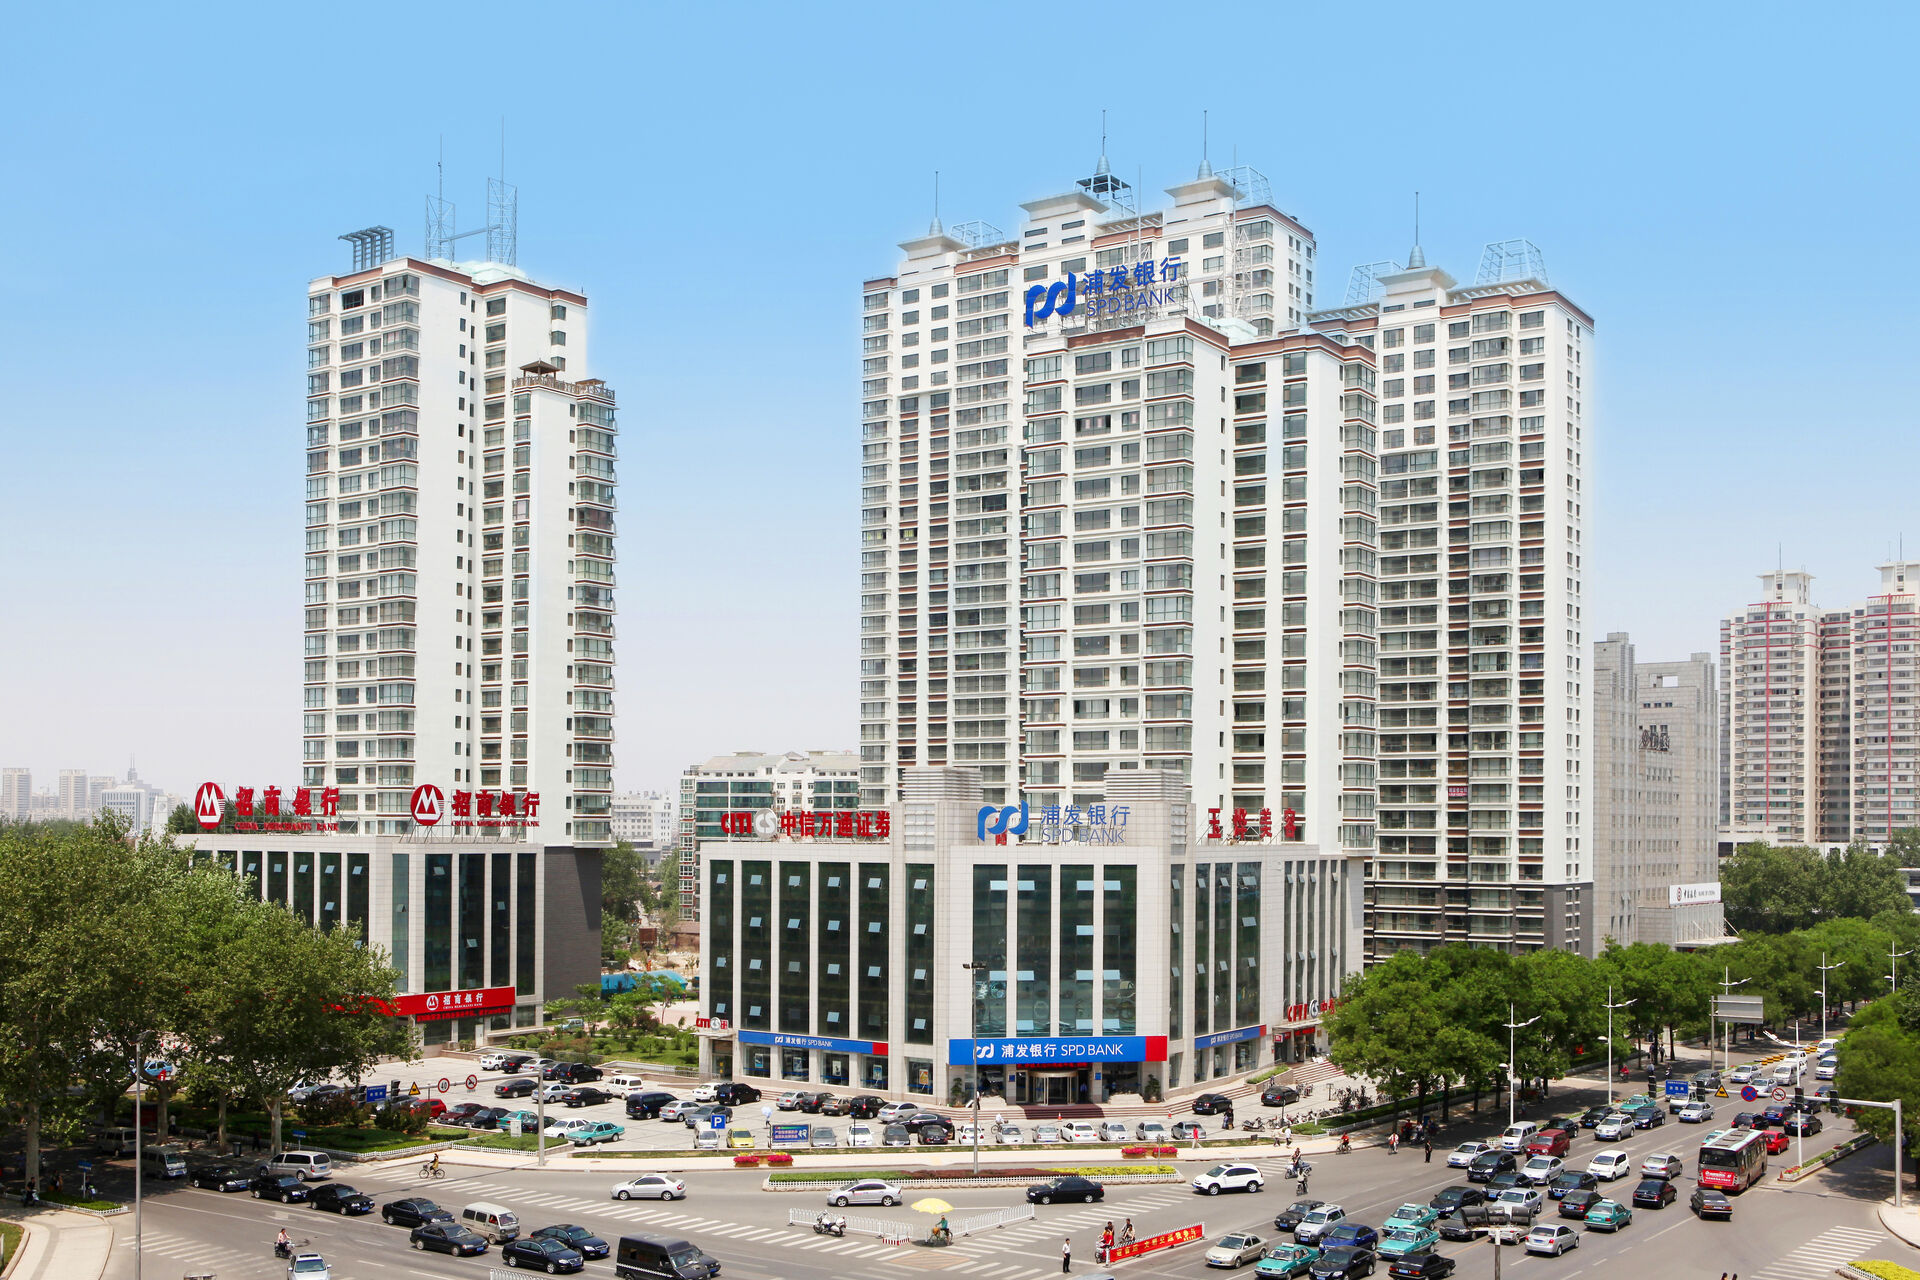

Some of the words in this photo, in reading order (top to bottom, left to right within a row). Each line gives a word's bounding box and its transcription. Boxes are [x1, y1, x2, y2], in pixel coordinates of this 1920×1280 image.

[1081, 256, 1182, 295] 浦发银行
[1086, 296, 1121, 317] SPD
[1124, 287, 1176, 312] BANK
[235, 785, 340, 817] 招商银行
[452, 789, 540, 817] 招商银行
[1041, 804, 1131, 826] 浦发银行
[234, 822, 258, 831] CHINA
[263, 822, 312, 831] MERCHANTS
[316, 822, 340, 831] BANK
[780, 810, 891, 837] 中信万通证券
[1041, 827, 1074, 843] SPD
[1079, 827, 1126, 843] BANK
[443, 993, 484, 1006] 招商银行
[785, 1036, 807, 1046] 浦发银行
[807, 1039, 818, 1047] SPD
[817, 1039, 833, 1048] BANK
[1001, 1043, 1057, 1058] 浦发银行
[1061, 1044, 1086, 1056] SPD
[1087, 1043, 1124, 1056] BANK
[714, 1117, 722, 1127] P
